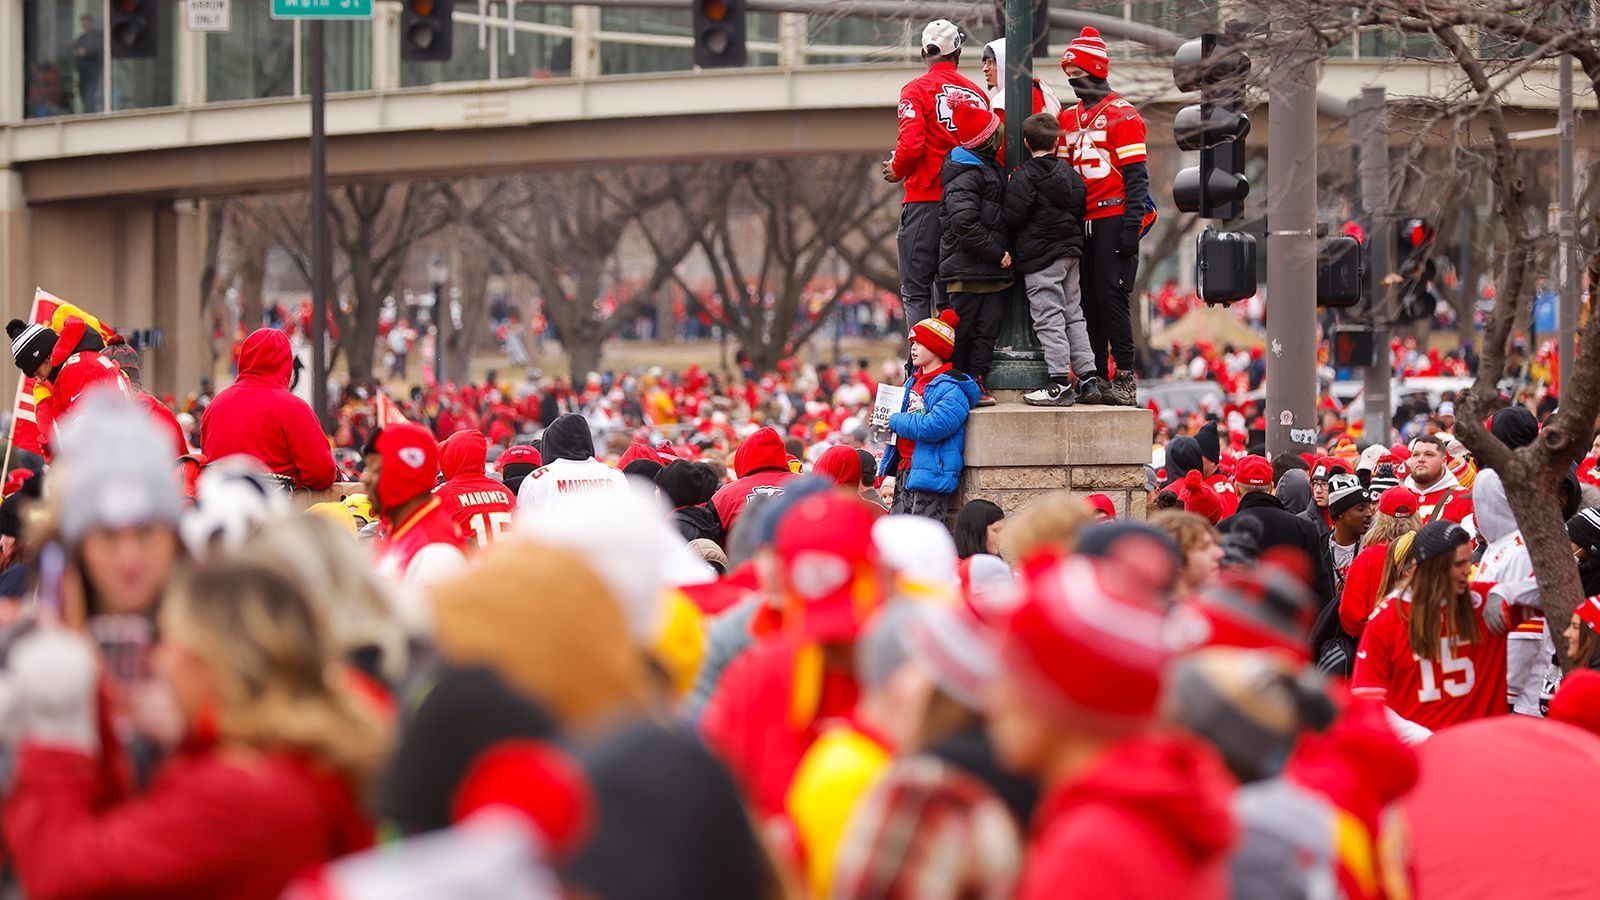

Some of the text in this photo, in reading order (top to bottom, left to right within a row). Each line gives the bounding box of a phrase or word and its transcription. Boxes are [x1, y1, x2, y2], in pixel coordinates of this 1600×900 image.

[194, 14, 221, 25] ONLY
[557, 479, 613, 494] MAHOMES
[458, 490, 509, 507] MAHOMES
[1413, 636, 1476, 703] 15
